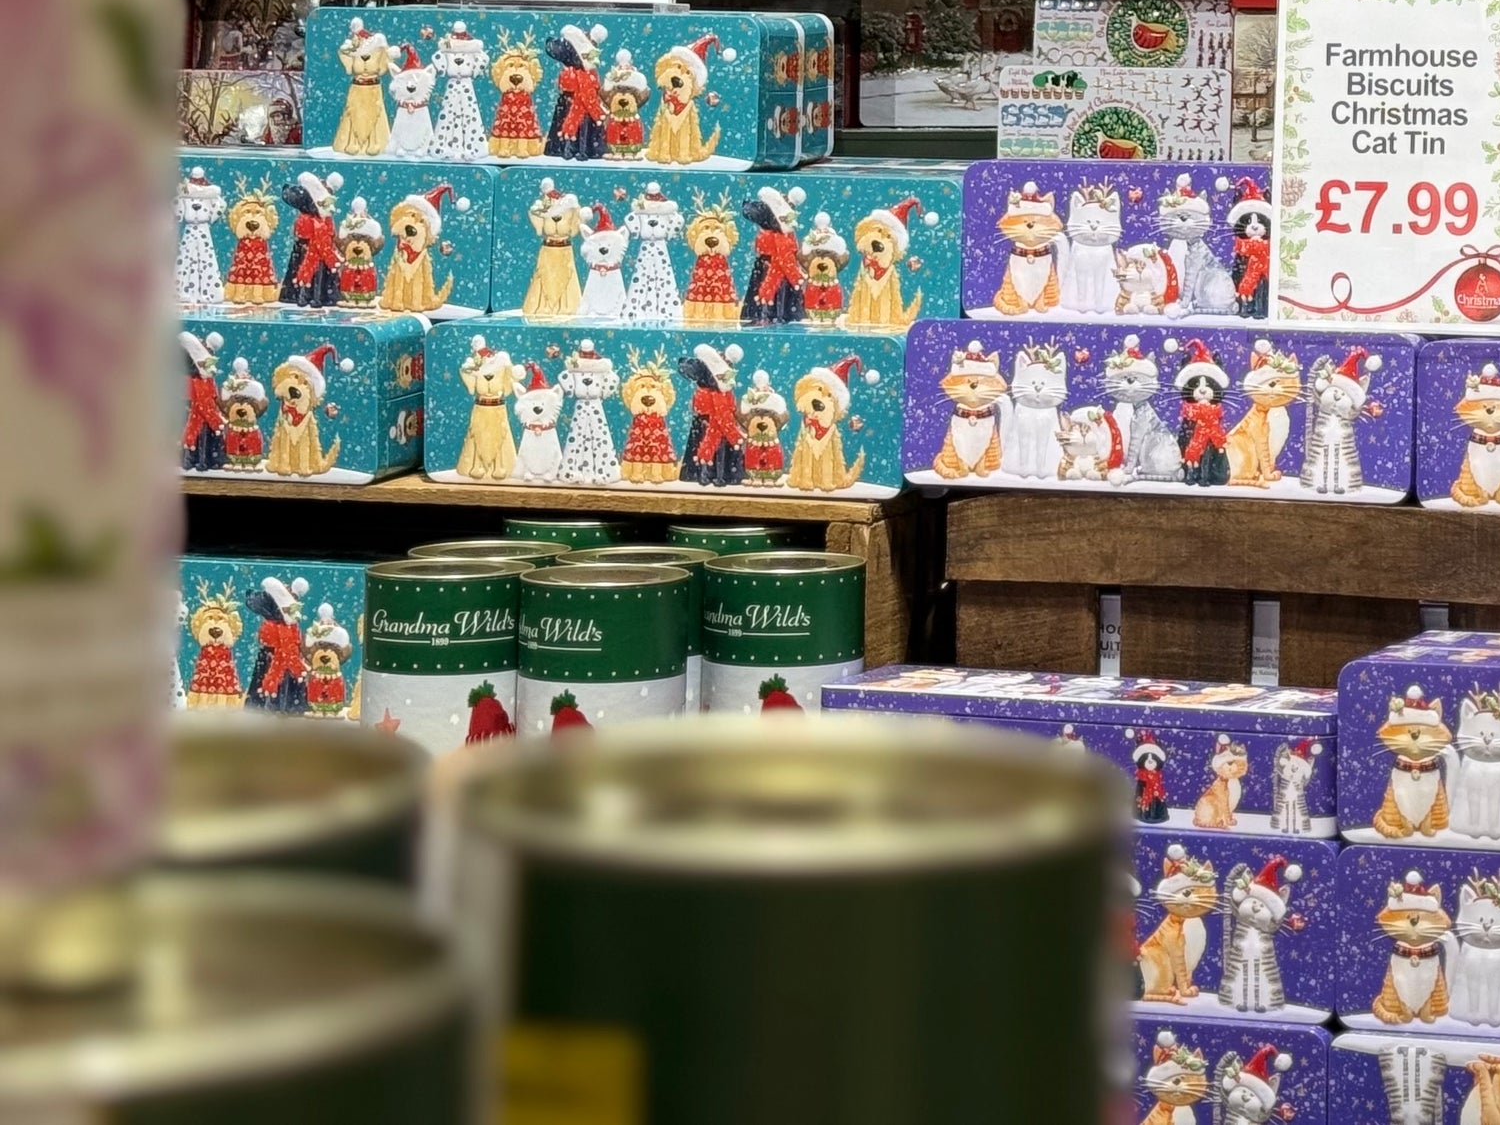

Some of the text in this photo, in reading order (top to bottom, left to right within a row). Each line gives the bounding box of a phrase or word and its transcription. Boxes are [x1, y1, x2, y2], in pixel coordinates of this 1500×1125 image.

[1325, 43, 1478, 68] Farmhouse
[1347, 72, 1454, 97] Biscuits
[1331, 101, 1468, 126] Christmas
[1352, 131, 1445, 155] Cat Tin
[1316, 180, 1478, 237] £7.99
[372, 609, 451, 637] Grandma
[454, 610, 515, 634] Wild's
[748, 605, 811, 629] Wild's
[541, 619, 602, 643] Wild's
